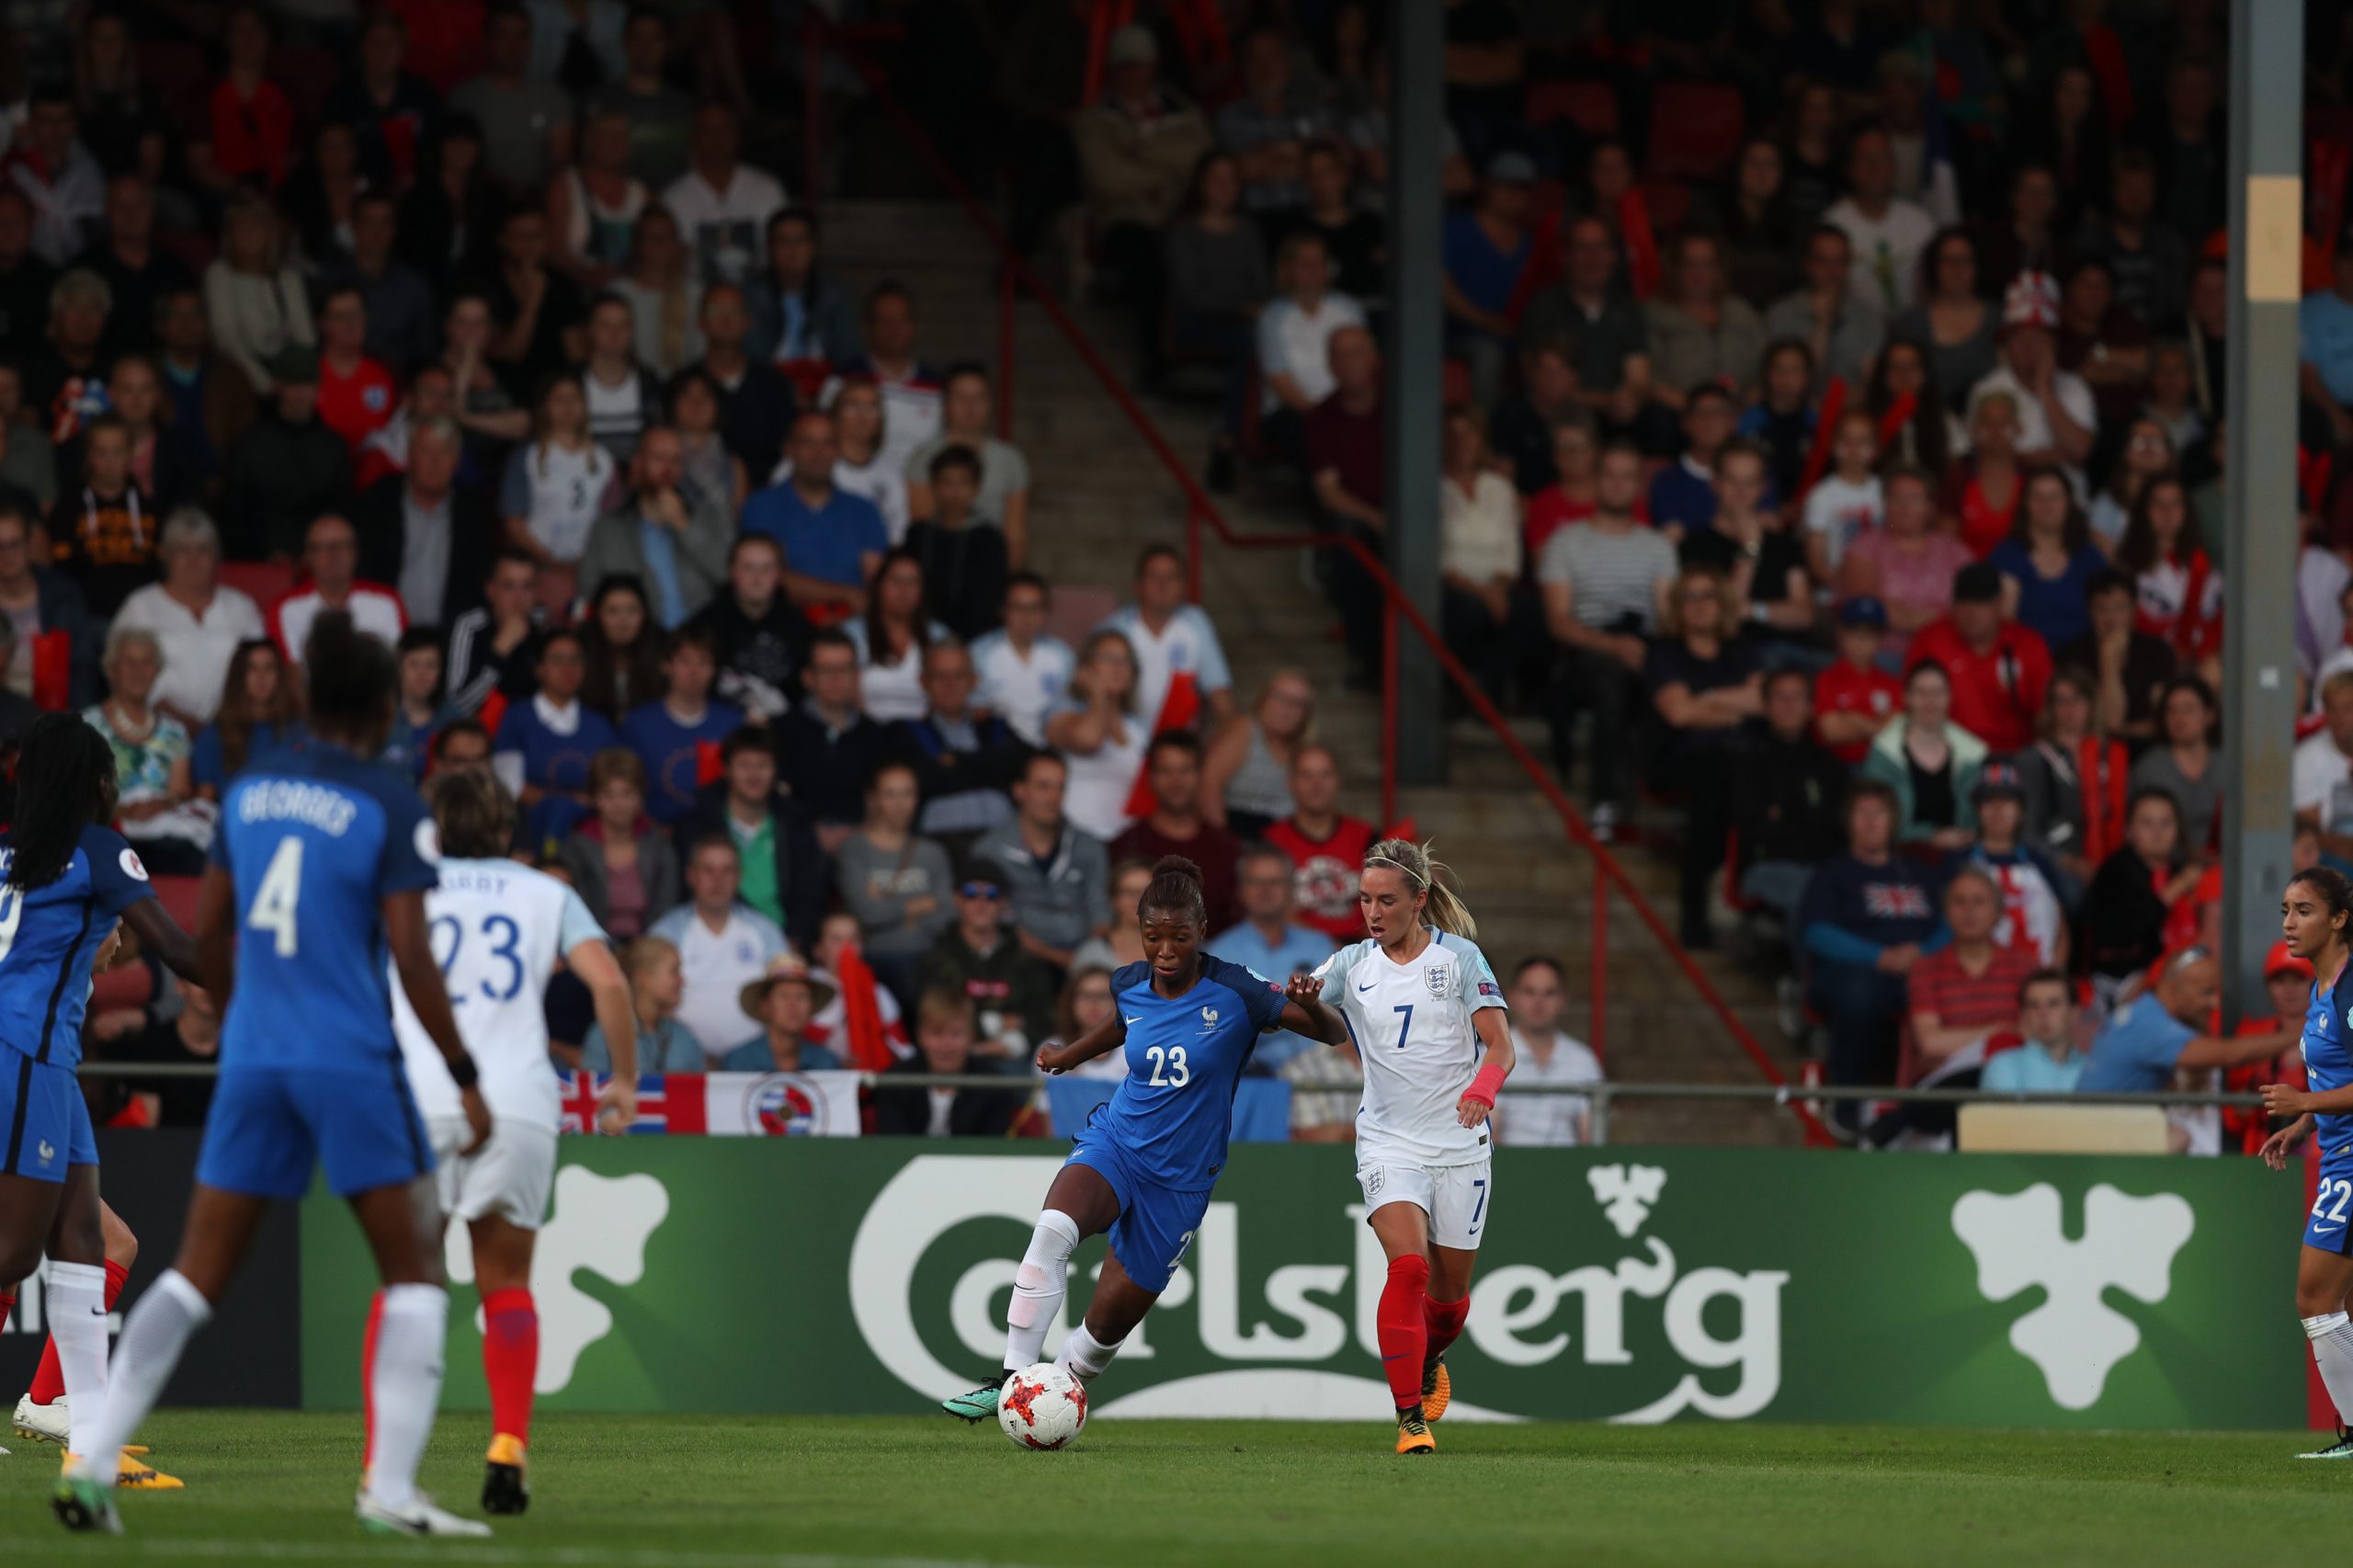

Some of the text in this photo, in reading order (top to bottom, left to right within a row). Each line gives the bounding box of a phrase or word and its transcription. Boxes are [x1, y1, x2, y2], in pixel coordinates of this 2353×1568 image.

[248, 834, 304, 959] 4
[429, 914, 524, 1003] 23
[1393, 1005, 1414, 1049] 7
[1146, 1046, 1199, 1087] 23
[1473, 1179, 1485, 1223] 7
[2311, 1176, 2352, 1223] 22
